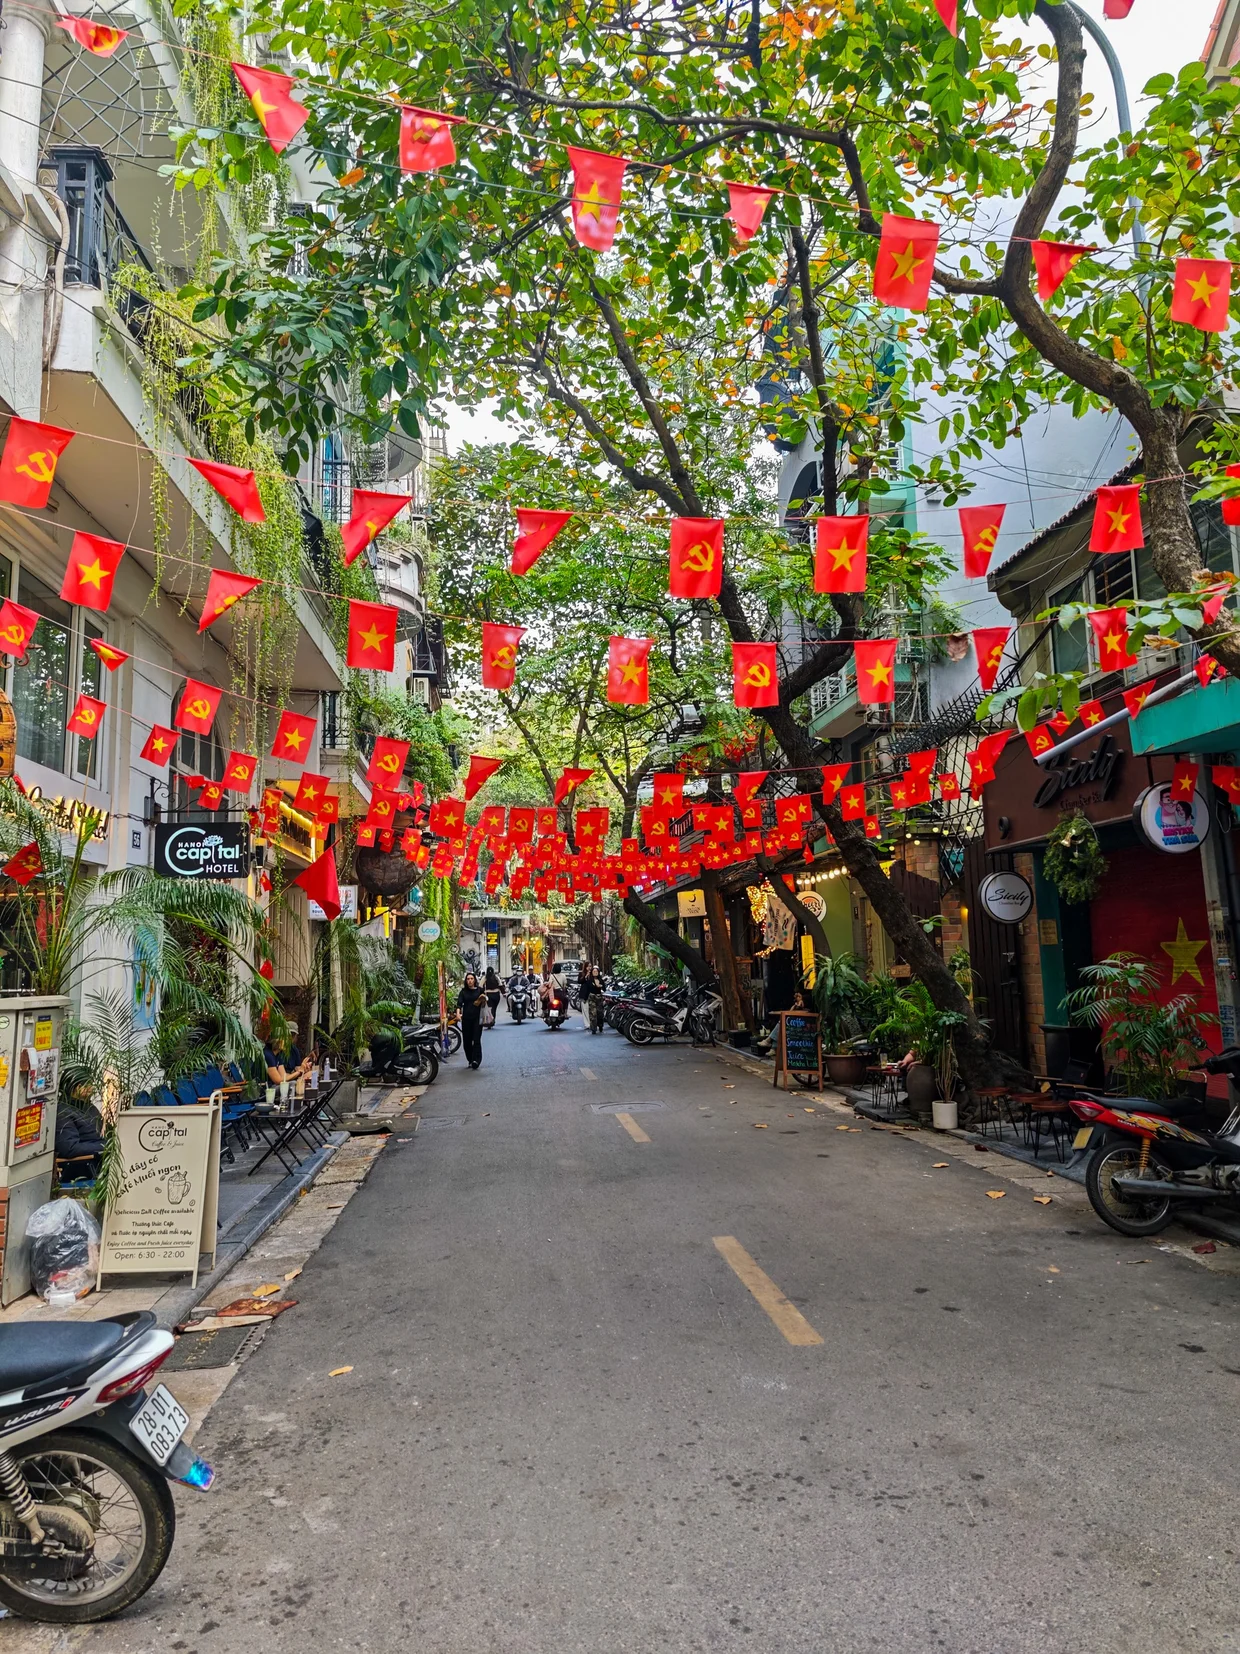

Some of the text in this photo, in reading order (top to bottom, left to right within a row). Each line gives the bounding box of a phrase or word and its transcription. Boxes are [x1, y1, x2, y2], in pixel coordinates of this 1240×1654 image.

[205, 864, 239, 873] HOTEL
[988, 888, 1029, 906] Sicily
[157, 1164, 182, 1176] ngon
[114, 1251, 136, 1260] Open:
[138, 1251, 156, 1259] 6:30
[163, 1250, 185, 1259] 22:00
[150, 1406, 188, 1460] 083.73
